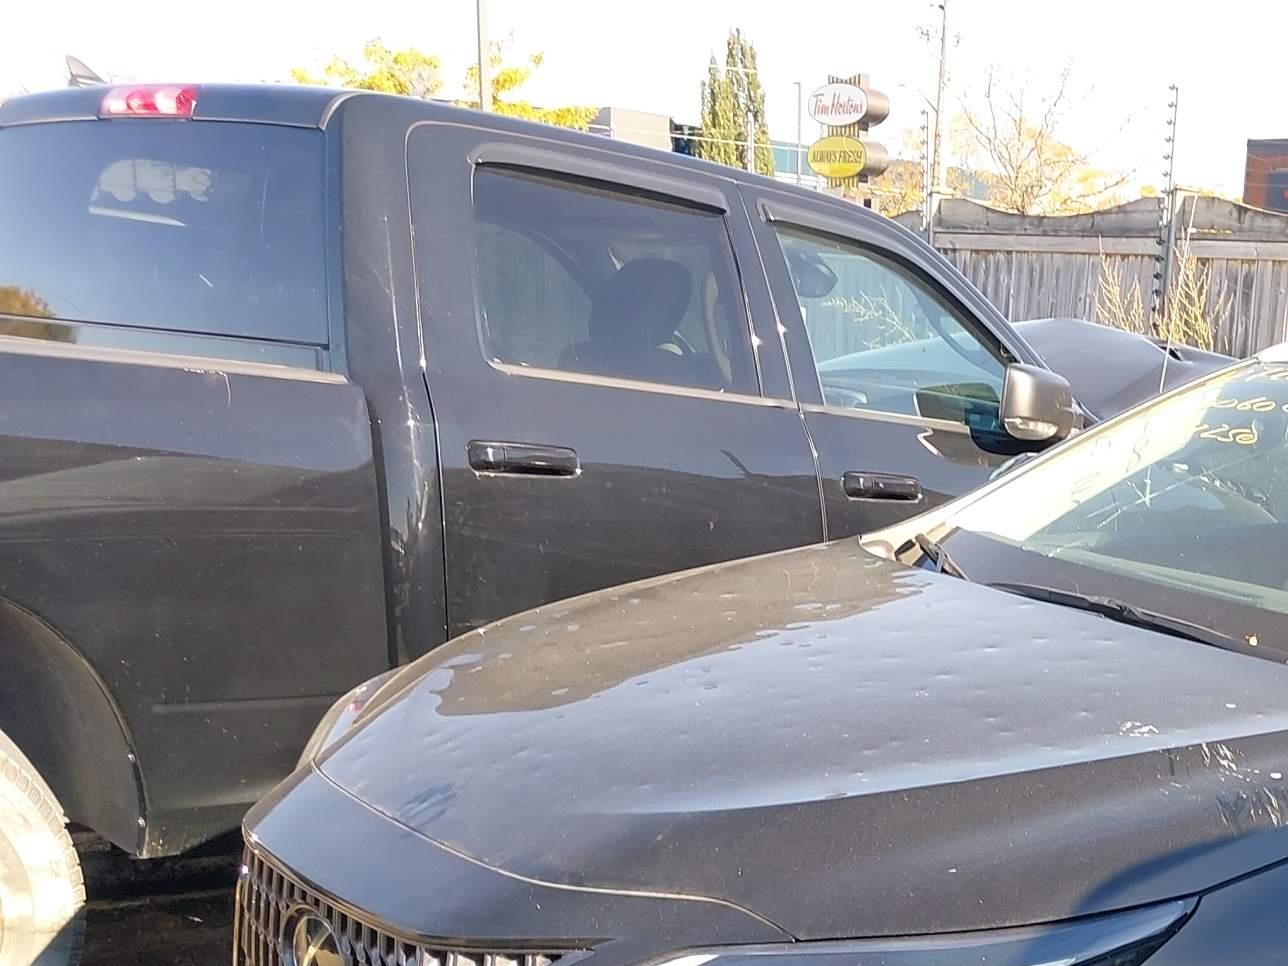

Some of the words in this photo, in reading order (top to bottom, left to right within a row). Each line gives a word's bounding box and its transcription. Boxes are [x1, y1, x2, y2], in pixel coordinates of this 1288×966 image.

[813, 93, 829, 116] Tim
[830, 92, 863, 116] Hortons
[811, 150, 837, 163] ALWAYS
[838, 150, 863, 164] FRESH
